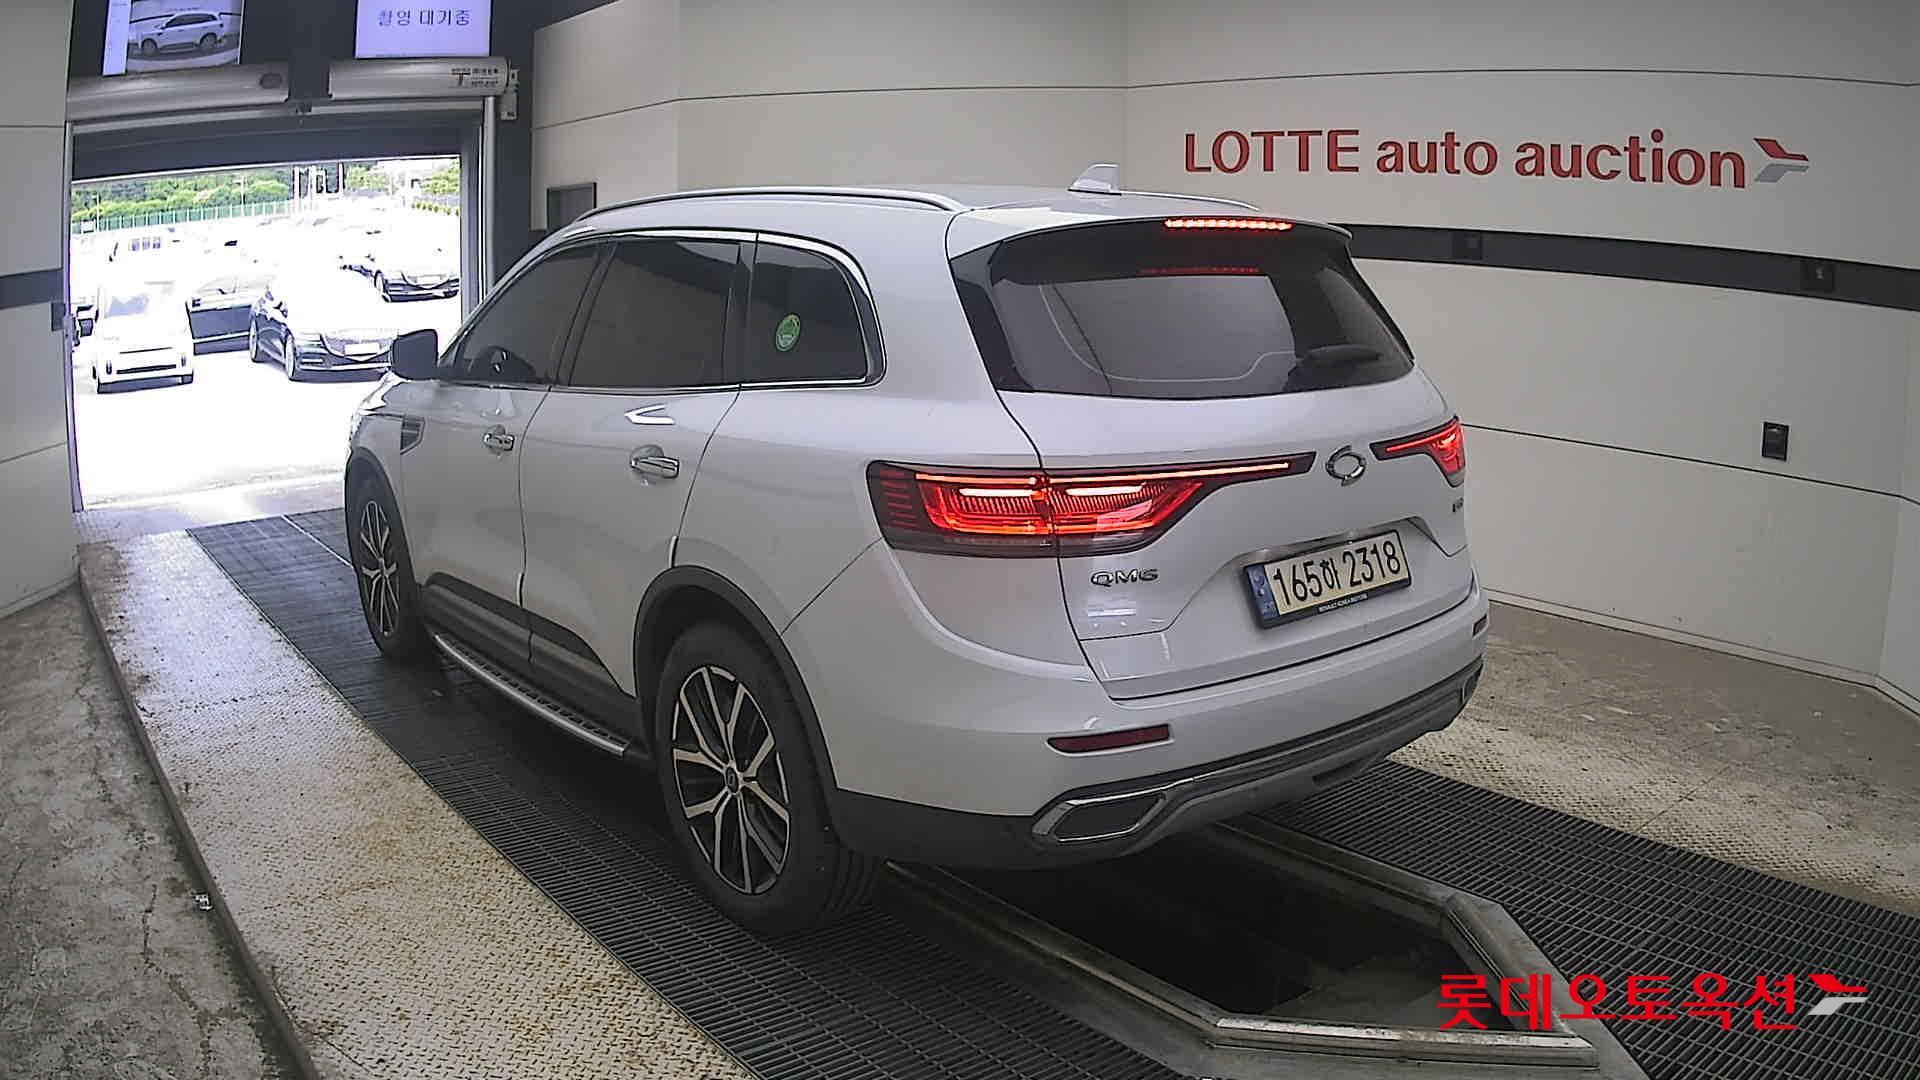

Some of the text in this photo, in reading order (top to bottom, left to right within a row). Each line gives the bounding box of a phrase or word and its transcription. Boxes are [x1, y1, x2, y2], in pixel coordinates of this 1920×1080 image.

[419, 9, 471, 26] 대기중
[1185, 129, 1746, 188] LOTTE auto auction
[1090, 568, 1158, 587] QM6
[1273, 558, 1341, 605] 165하
[1342, 541, 1401, 587] 2318
